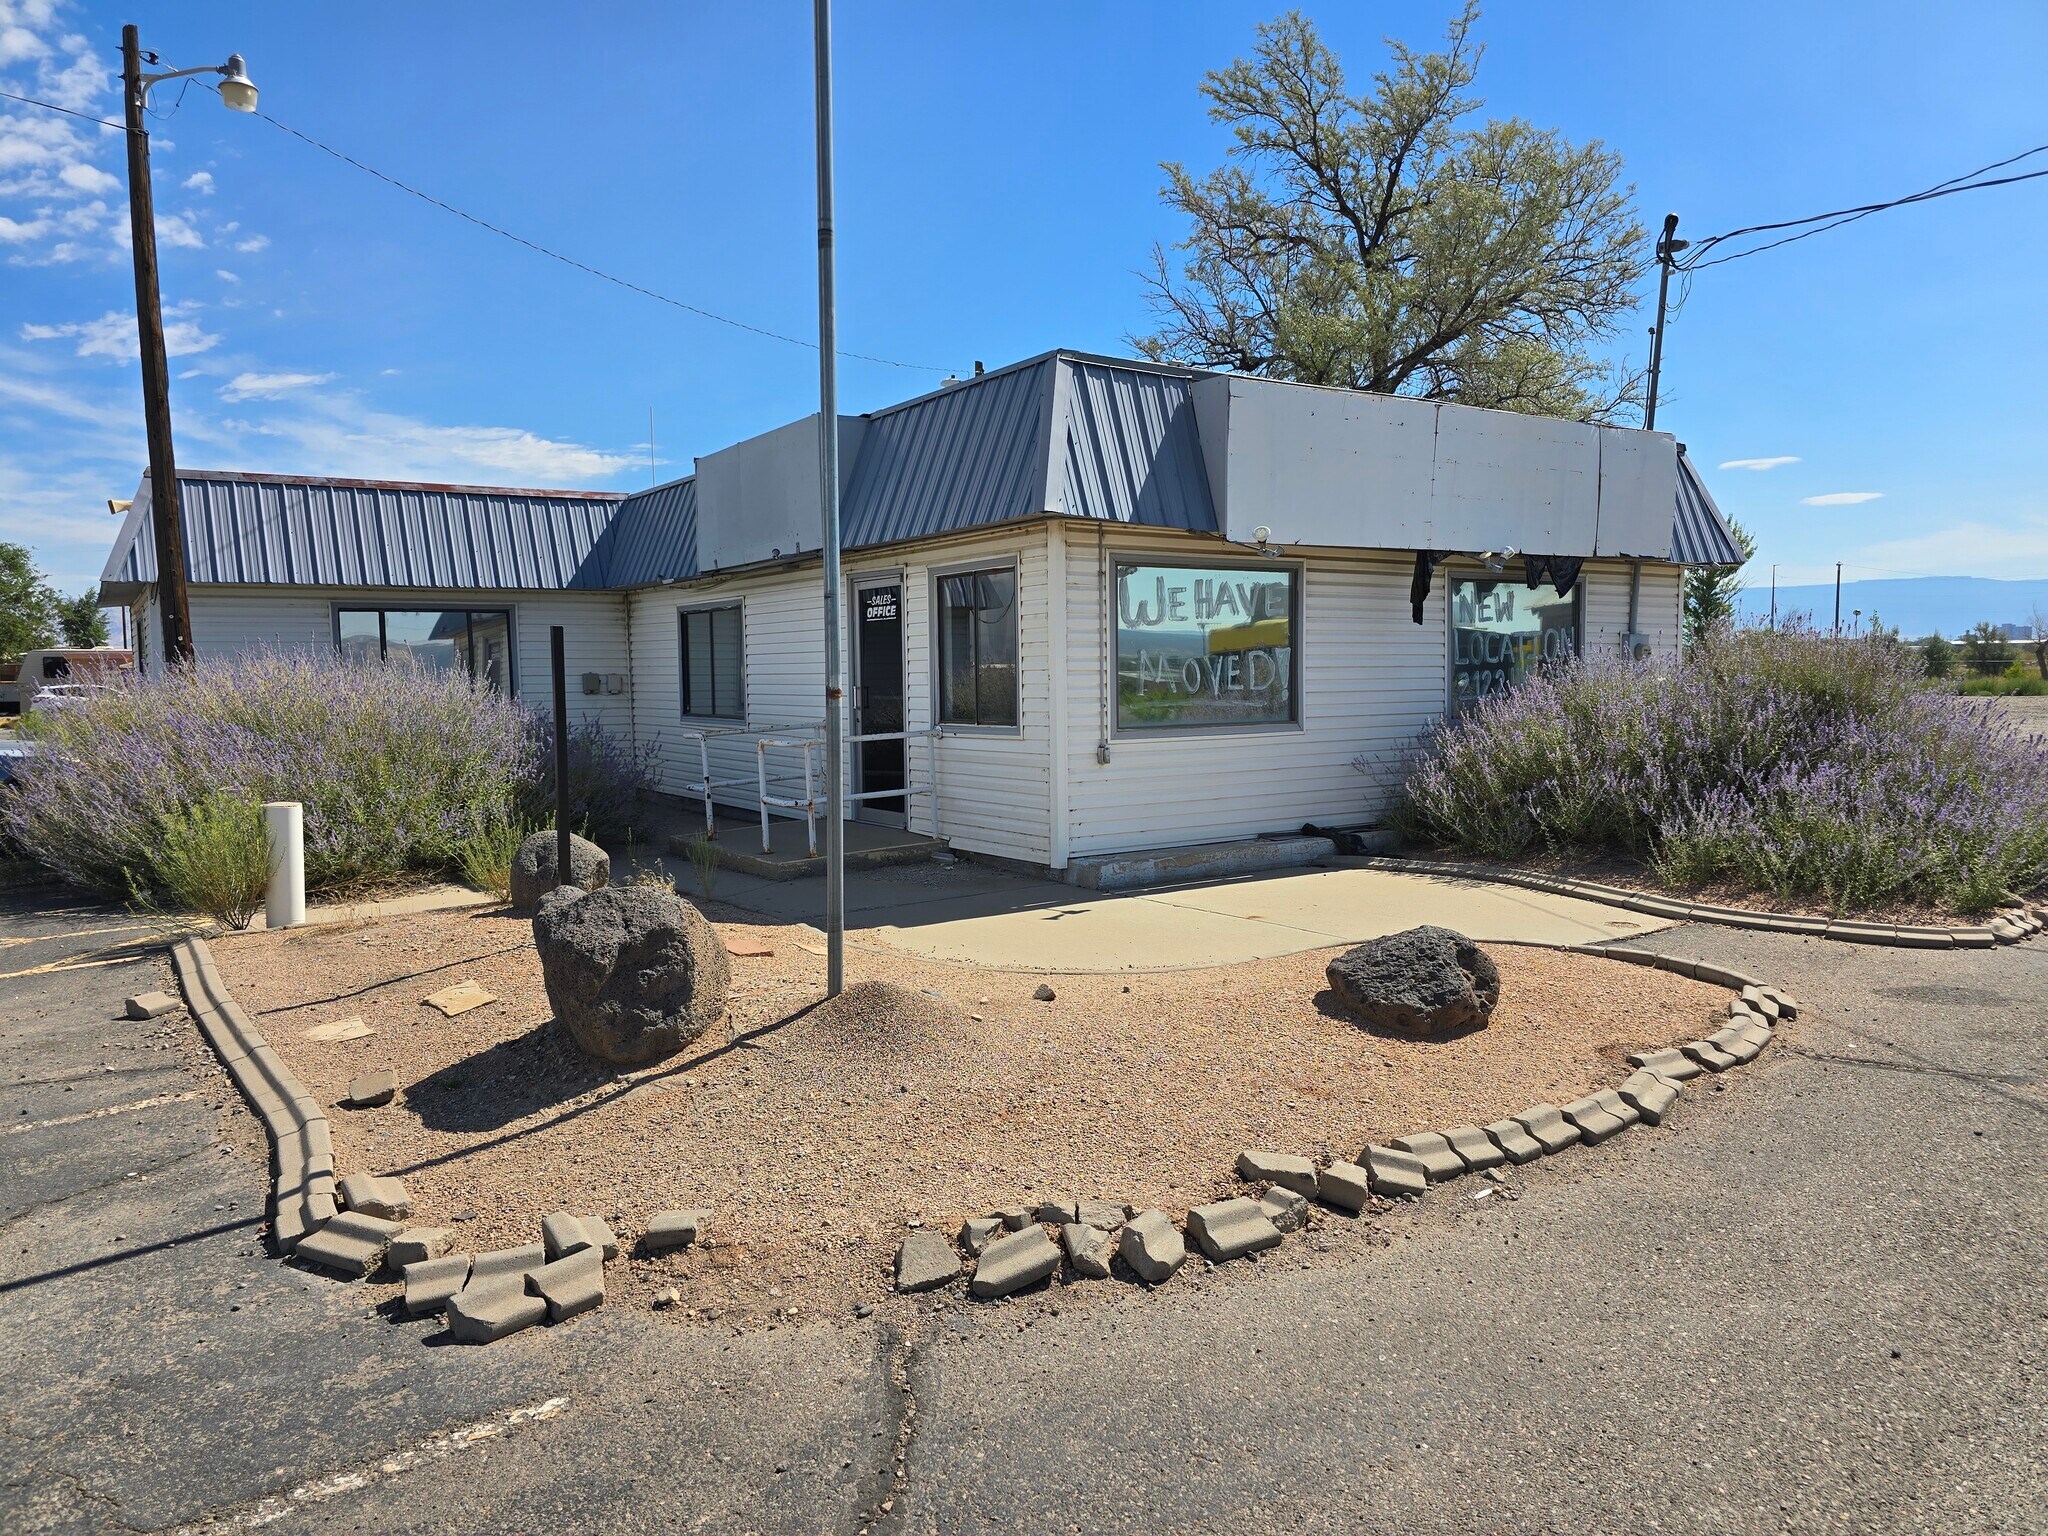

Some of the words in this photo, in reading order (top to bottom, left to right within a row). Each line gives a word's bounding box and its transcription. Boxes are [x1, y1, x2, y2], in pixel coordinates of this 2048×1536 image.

[867, 605, 896, 618] OFFICE
[1119, 576, 1188, 629] WE
[1194, 579, 1287, 620] HAVE
[1459, 590, 1515, 623] NEW
[1454, 626, 1574, 665] LOCATION
[1138, 647, 1291, 700] MOVED!
